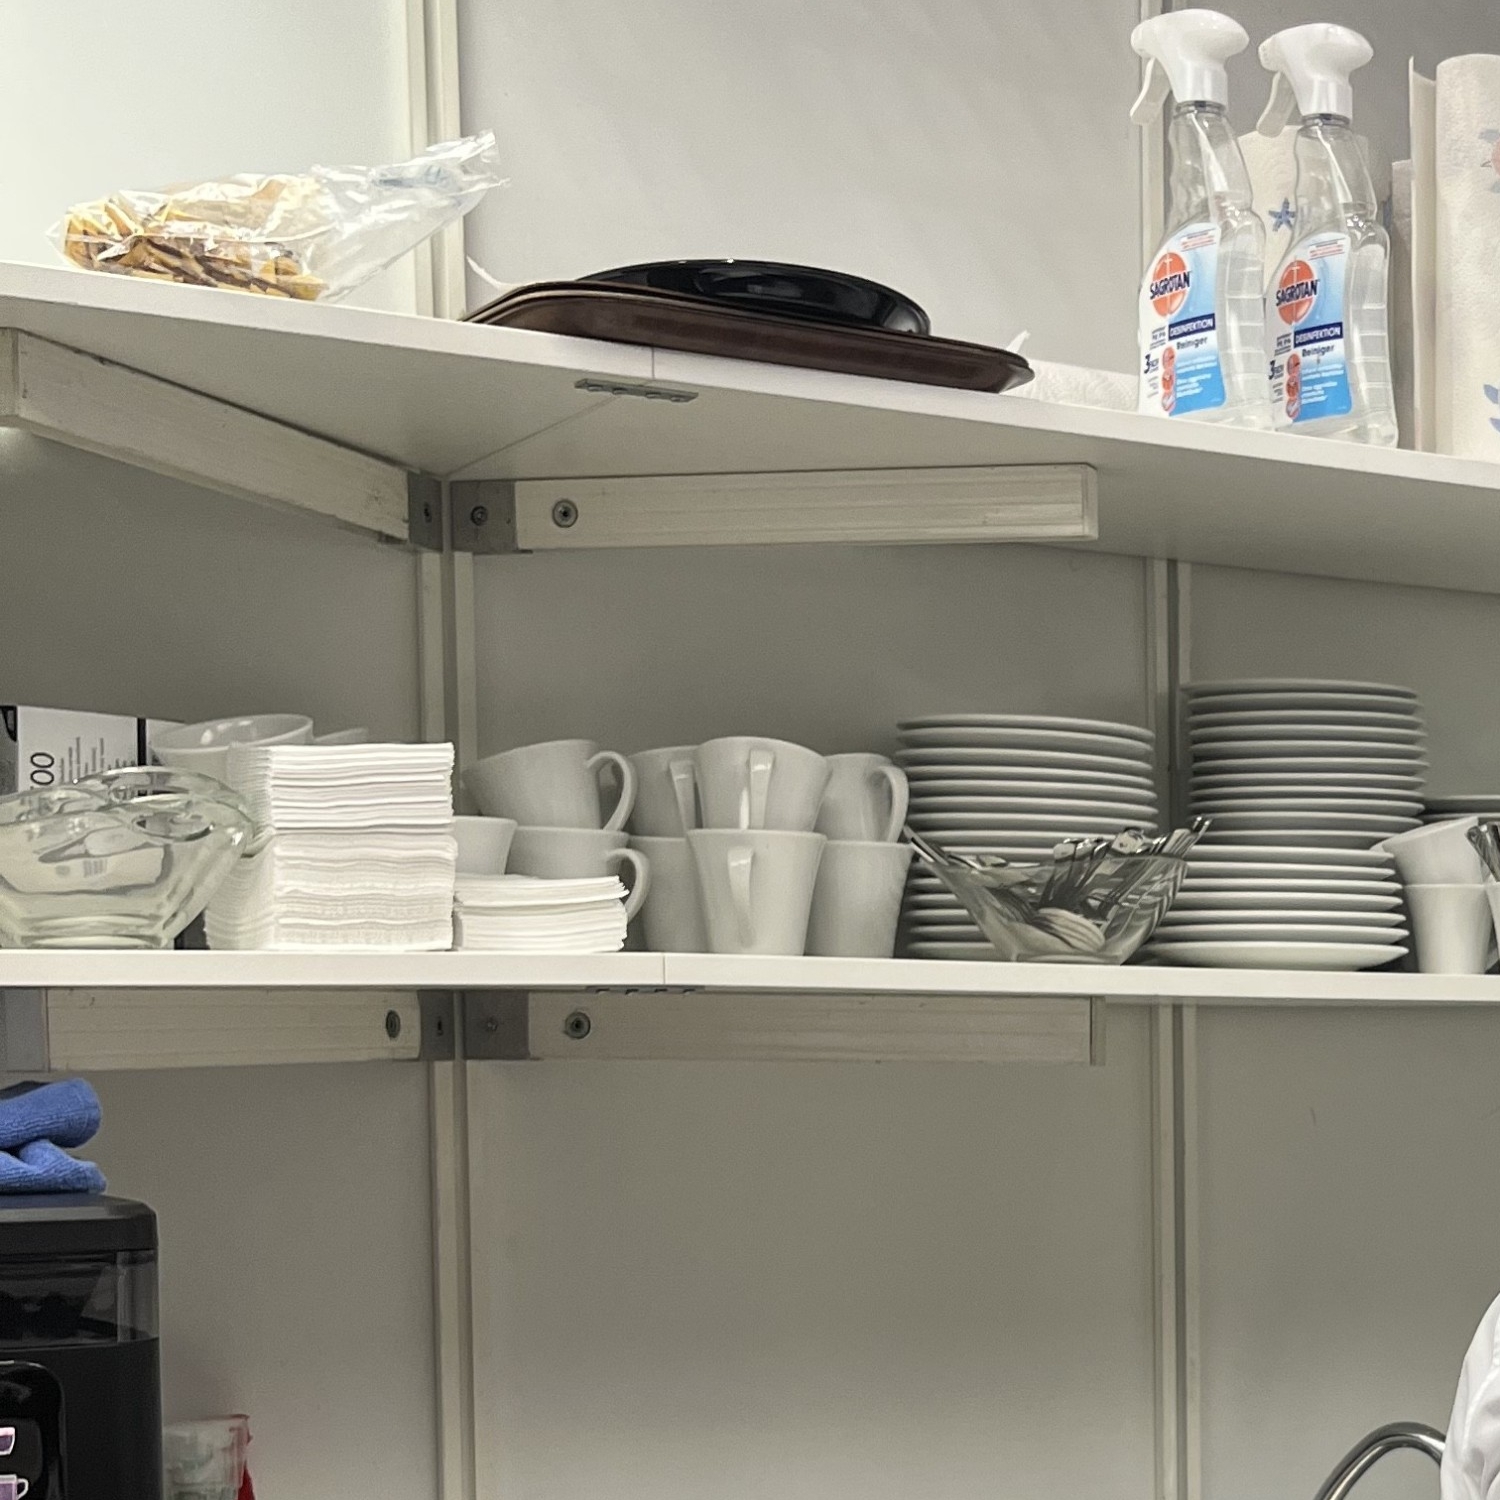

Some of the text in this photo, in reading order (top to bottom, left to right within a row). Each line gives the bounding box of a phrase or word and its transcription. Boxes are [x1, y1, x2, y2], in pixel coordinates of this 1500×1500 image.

[1150, 271, 1190, 300] SAGROTAN
[1276, 279, 1319, 306] SAGROTAN
[1176, 336, 1208, 350] Reiniger
[1295, 327, 1342, 345] DESINFEKTION
[1302, 344, 1335, 358] Reiniger
[30, 752, 55, 787] 00
